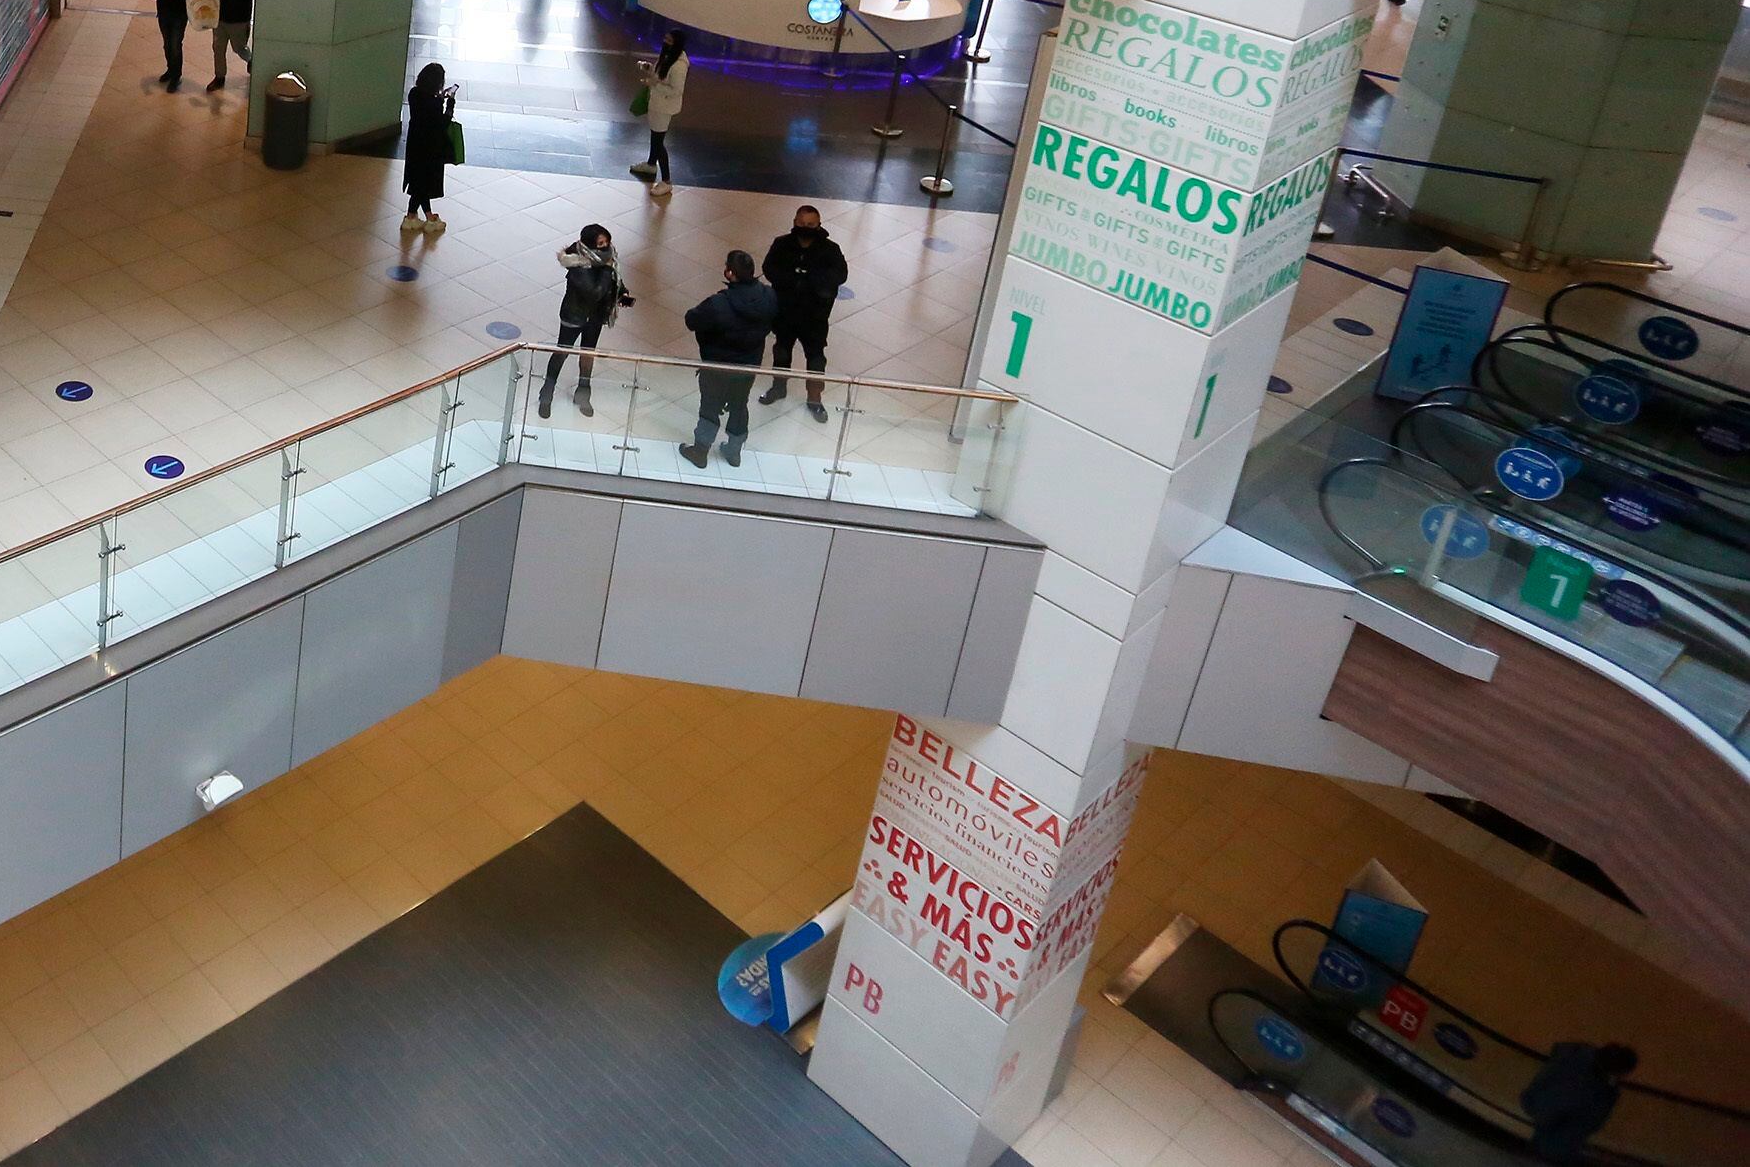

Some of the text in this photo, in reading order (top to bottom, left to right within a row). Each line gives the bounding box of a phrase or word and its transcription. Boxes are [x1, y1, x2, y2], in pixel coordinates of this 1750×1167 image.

[1054, 54, 1145, 92] accesorios
[1061, 17, 1276, 108] REGALOS
[1280, 38, 1368, 104] REGALOS
[1043, 93, 1139, 145] GIFTS
[1147, 128, 1251, 186] GIFTS
[1048, 73, 1097, 102] libros
[1123, 97, 1176, 128] books
[1204, 124, 1259, 157] libros
[1032, 125, 1241, 234] REGALOS
[1243, 149, 1335, 236] REGALOS
[1022, 208, 1080, 240] VINOS
[1087, 232, 1146, 267] WINES
[1154, 258, 1217, 296] VINOS
[1023, 185, 1077, 217] GIFTS
[1093, 210, 1149, 244] GIFTS
[1166, 239, 1225, 274] GIFTS
[1010, 287, 1047, 315] NIVEL
[1011, 230, 1211, 328] JUMBO JUMBO
[1006, 311, 1033, 378] 1
[1194, 373, 1217, 439] 1
[1549, 574, 1570, 609] 1
[886, 756, 1054, 879] automóviles
[893, 713, 1060, 846] BELLEZA
[881, 775, 950, 827] servicios
[954, 821, 1048, 894] financieros
[943, 833, 972, 856] SALUD
[1023, 832, 1058, 861] tourism
[869, 815, 1033, 950] SERVICIOS
[886, 870, 993, 963] & MÁS
[1003, 889, 1041, 921] CARS
[844, 962, 884, 1014] PB
[851, 878, 929, 948] EASY
[932, 939, 1014, 1015] EASY
[1382, 998, 1420, 1033] PB
